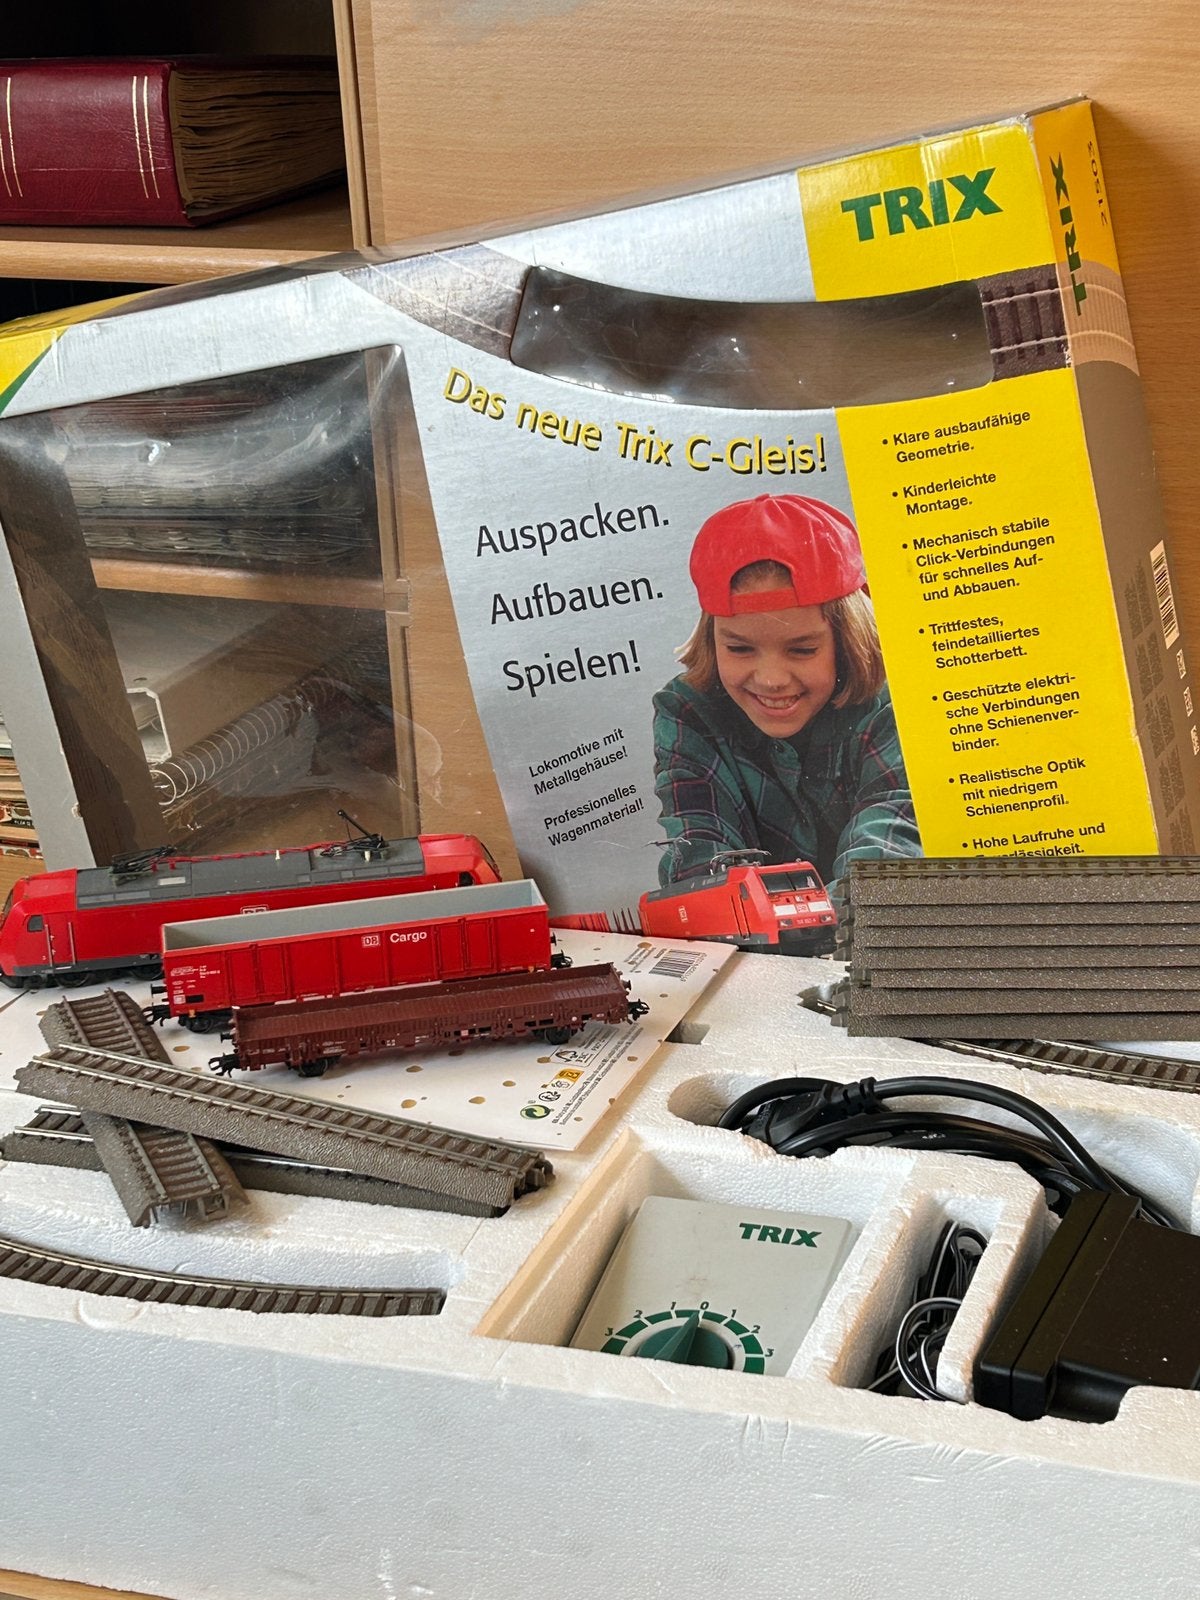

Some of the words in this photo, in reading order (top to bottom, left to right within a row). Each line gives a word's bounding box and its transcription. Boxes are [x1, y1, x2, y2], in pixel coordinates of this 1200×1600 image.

[840, 167, 1003, 242] TRIX
[1049, 152, 1087, 316] TRIX
[443, 367, 506, 420] Das
[515, 401, 602, 452] neue
[614, 421, 674, 467] Trix
[684, 432, 827, 475] C-Gleis!
[893, 428, 930, 446] Klare
[934, 410, 1031, 439] ausbaufähige
[896, 442, 975, 464] Geometrie.
[902, 472, 997, 499] Kinderleichte
[905, 495, 973, 516] Montage.
[476, 502, 670, 557] Auspacken.
[912, 525, 998, 551] Mechanisch
[1002, 516, 1050, 535] stabile
[916, 533, 1056, 568] Click-Verbindungen
[919, 570, 939, 585] für
[943, 560, 1010, 582] schnelles
[1013, 556, 1044, 570] Auf-
[490, 575, 663, 625] Aufbauen.
[923, 588, 949, 602] und
[953, 577, 1021, 597] Abbauen.
[929, 615, 1004, 635] Trittfestes,
[932, 626, 1040, 652] feindetailliertes
[502, 640, 641, 698] Spielen!
[936, 646, 1028, 669] Schotterbett.
[943, 680, 1022, 702] Geschützte
[1025, 672, 1076, 691] elektri-
[946, 704, 979, 719] sche
[982, 689, 1080, 714] Verbindungen
[949, 721, 984, 736] ohne
[987, 709, 1080, 730] Schienenver-
[529, 740, 600, 778] Lokomotive
[603, 728, 625, 746] mit
[952, 736, 1000, 752] binder.
[534, 745, 628, 795] Metallgehäuse!
[959, 762, 1044, 785] Realistische
[1047, 757, 1086, 773] Optik
[963, 789, 986, 801] mit
[988, 777, 1058, 800] niedrigem
[544, 783, 637, 830] Professionelles
[966, 794, 1070, 817] Schienenprofil.
[548, 797, 644, 846] Wagenmaterial!
[973, 836, 1009, 850] Hohe
[1013, 828, 1075, 845] Laufruhe
[1079, 822, 1106, 836] und
[390, 930, 427, 944] Cargo
[739, 1222, 822, 1248] TRIX
[633, 1310, 643, 1318] 2
[670, 1301, 677, 1310] 1
[700, 1301, 709, 1310] 0
[730, 1309, 737, 1318] 1
[751, 1325, 761, 1334] 2
[764, 1348, 774, 1357] 3
